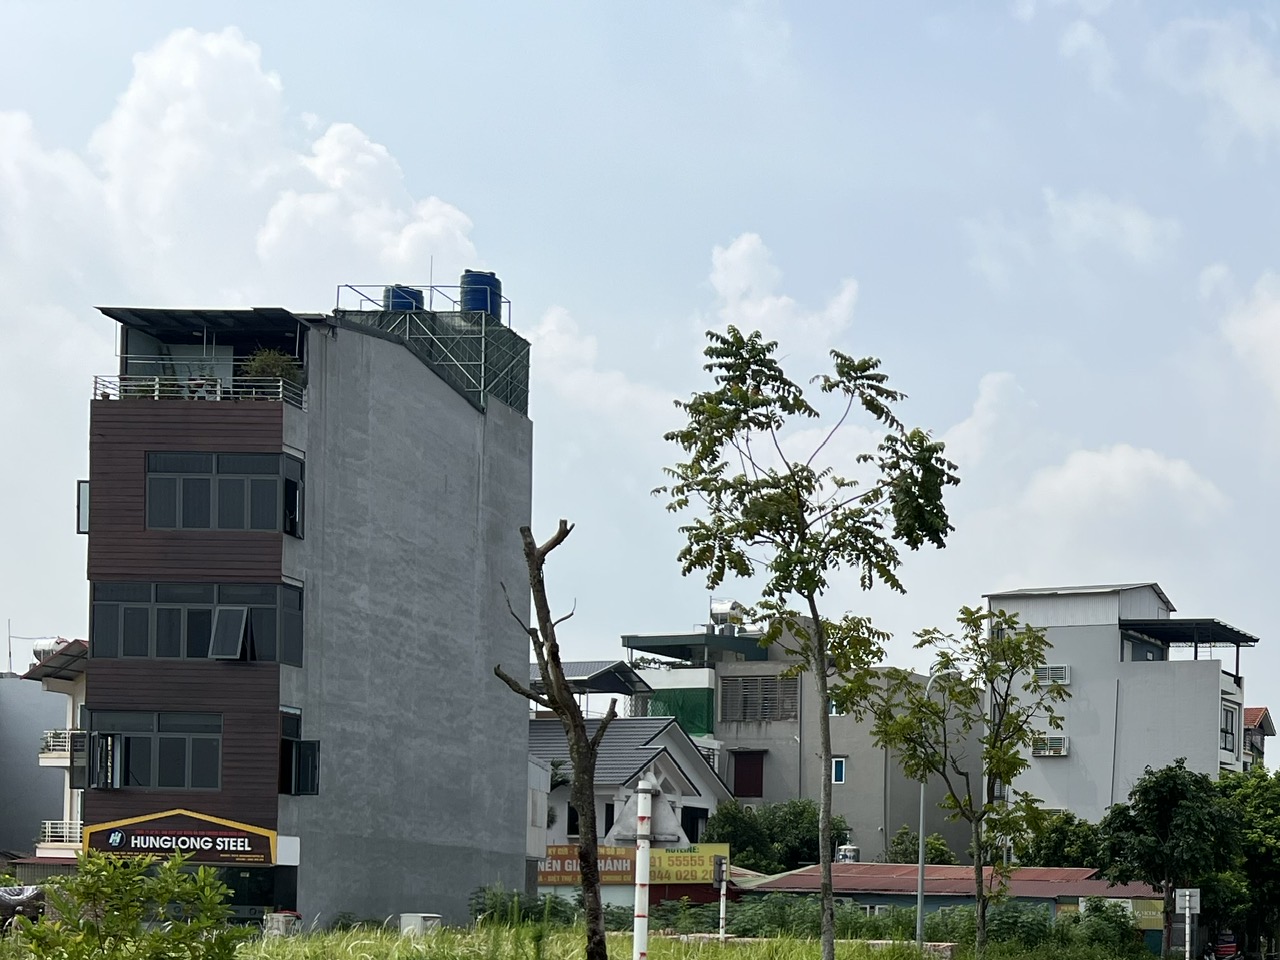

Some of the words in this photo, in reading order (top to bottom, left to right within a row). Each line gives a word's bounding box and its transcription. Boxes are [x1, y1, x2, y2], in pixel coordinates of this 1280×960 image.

[131, 835, 214, 850] HUNGLONG
[215, 838, 252, 851] STEEL
[597, 857, 631, 871] HÁNH
[667, 856, 705, 867] 55555
[675, 869, 698, 881] 029
